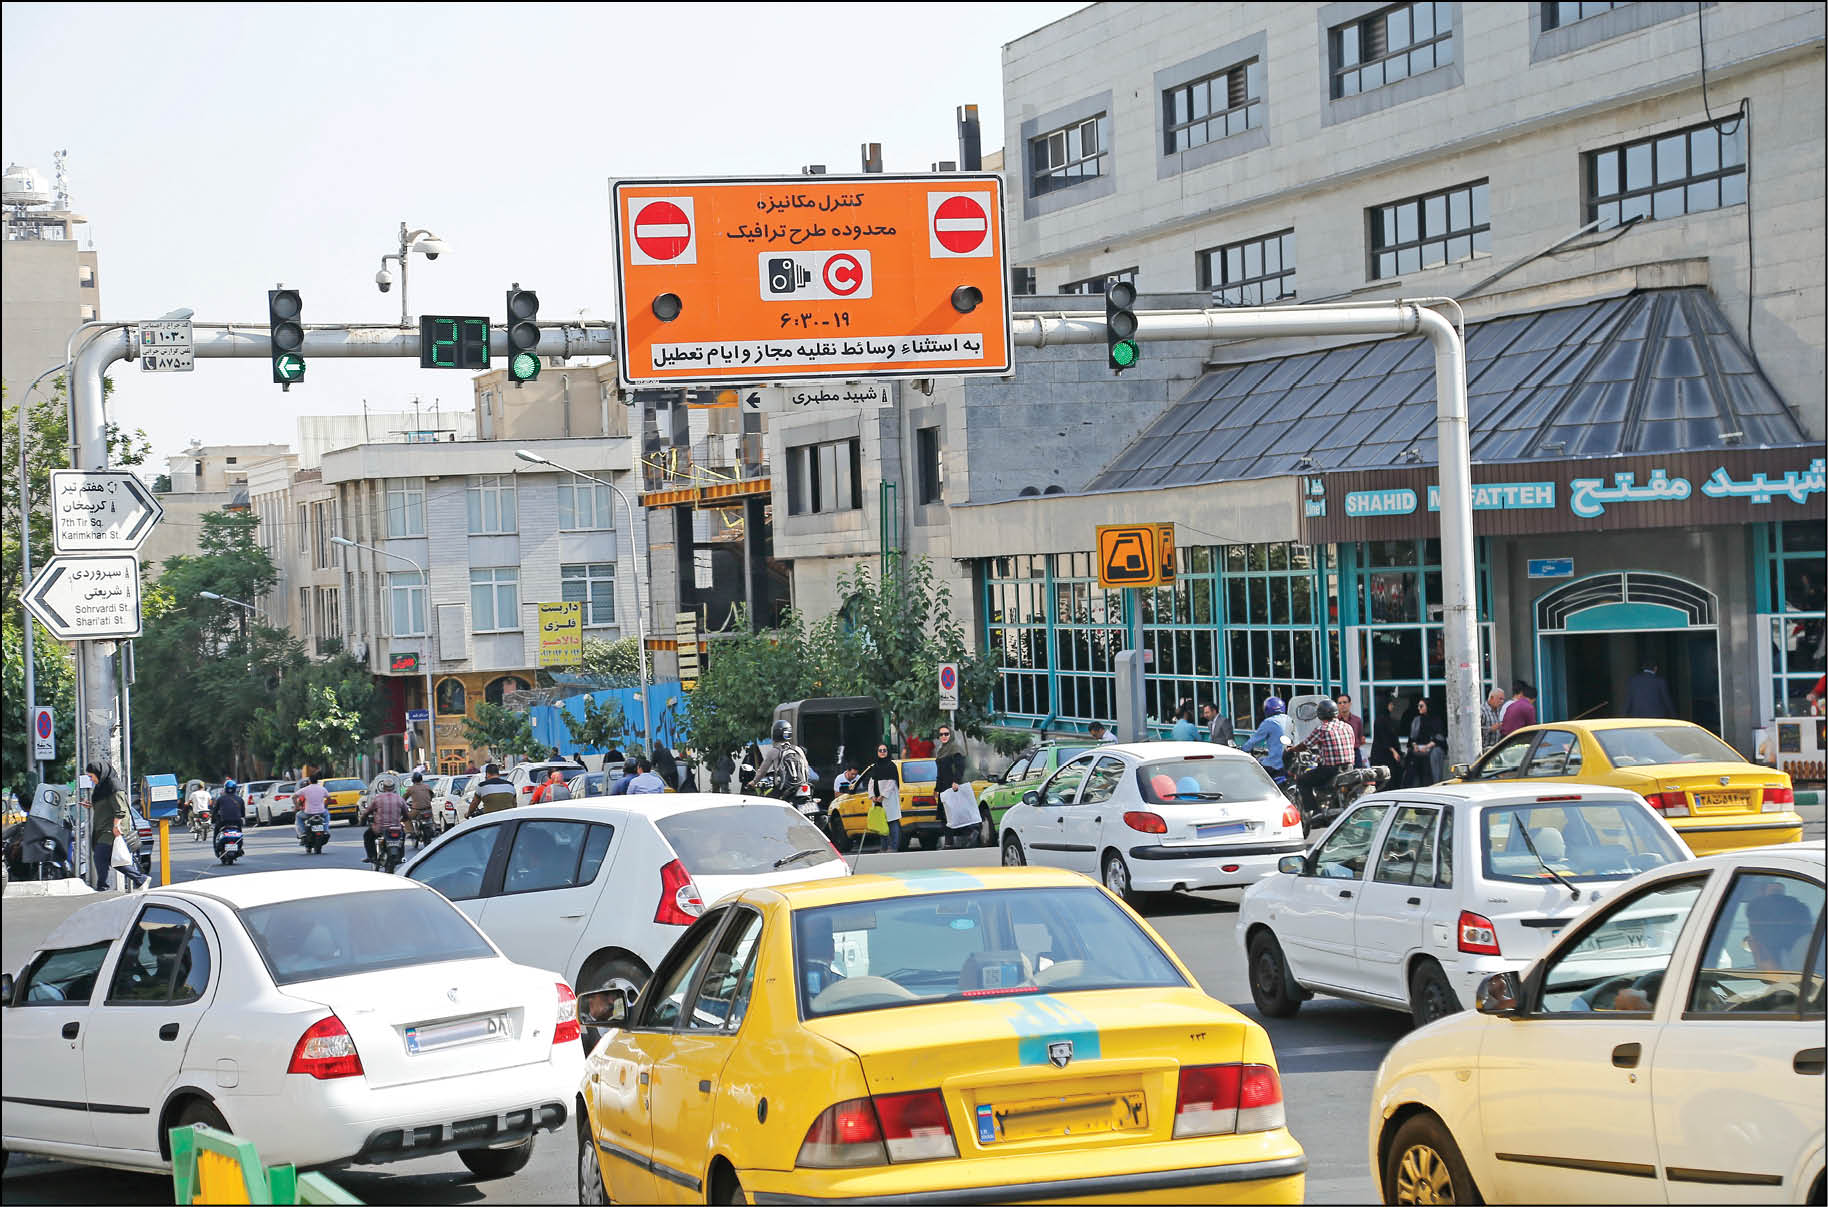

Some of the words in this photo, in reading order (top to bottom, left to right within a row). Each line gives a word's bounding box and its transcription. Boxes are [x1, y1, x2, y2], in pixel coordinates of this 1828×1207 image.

[756, 195, 816, 214] مکانیزه
[818, 193, 865, 212] کنترل
[726, 222, 787, 243] ترافیک
[789, 224, 827, 245] طرح
[831, 224, 897, 240] محدوده
[159, 332, 185, 342] ۱۰۳۰
[432, 318, 487, 367] 27
[707, 346, 739, 364] ایام
[754, 346, 793, 364] مجاز
[797, 343, 837, 359] نقلیه
[841, 341, 896, 357] وسائط
[963, 340, 981, 354] به
[159, 358, 191, 369] ۸۷۵۰۰
[653, 347, 703, 367] تعطیل
[792, 390, 840, 406] مطهری
[843, 387, 878, 403] شهید
[61, 482, 77, 495] تیر
[79, 482, 105, 497] هفتم
[1701, 459, 1826, 504] شهید
[1570, 469, 1692, 518] مفتح
[62, 500, 107, 513] کریمخان
[1346, 492, 1415, 513] SHAHID
[61, 518, 75, 527] 7th
[76, 518, 87, 527] Tir
[90, 518, 104, 528] Sq.
[61, 531, 107, 540] Karimkhan
[72, 569, 122, 581] سهروردی
[84, 585, 122, 600] شریعتی
[75, 604, 116, 614] Sohrvardi
[541, 603, 578, 614] داربست
[544, 618, 576, 631] فلزی
